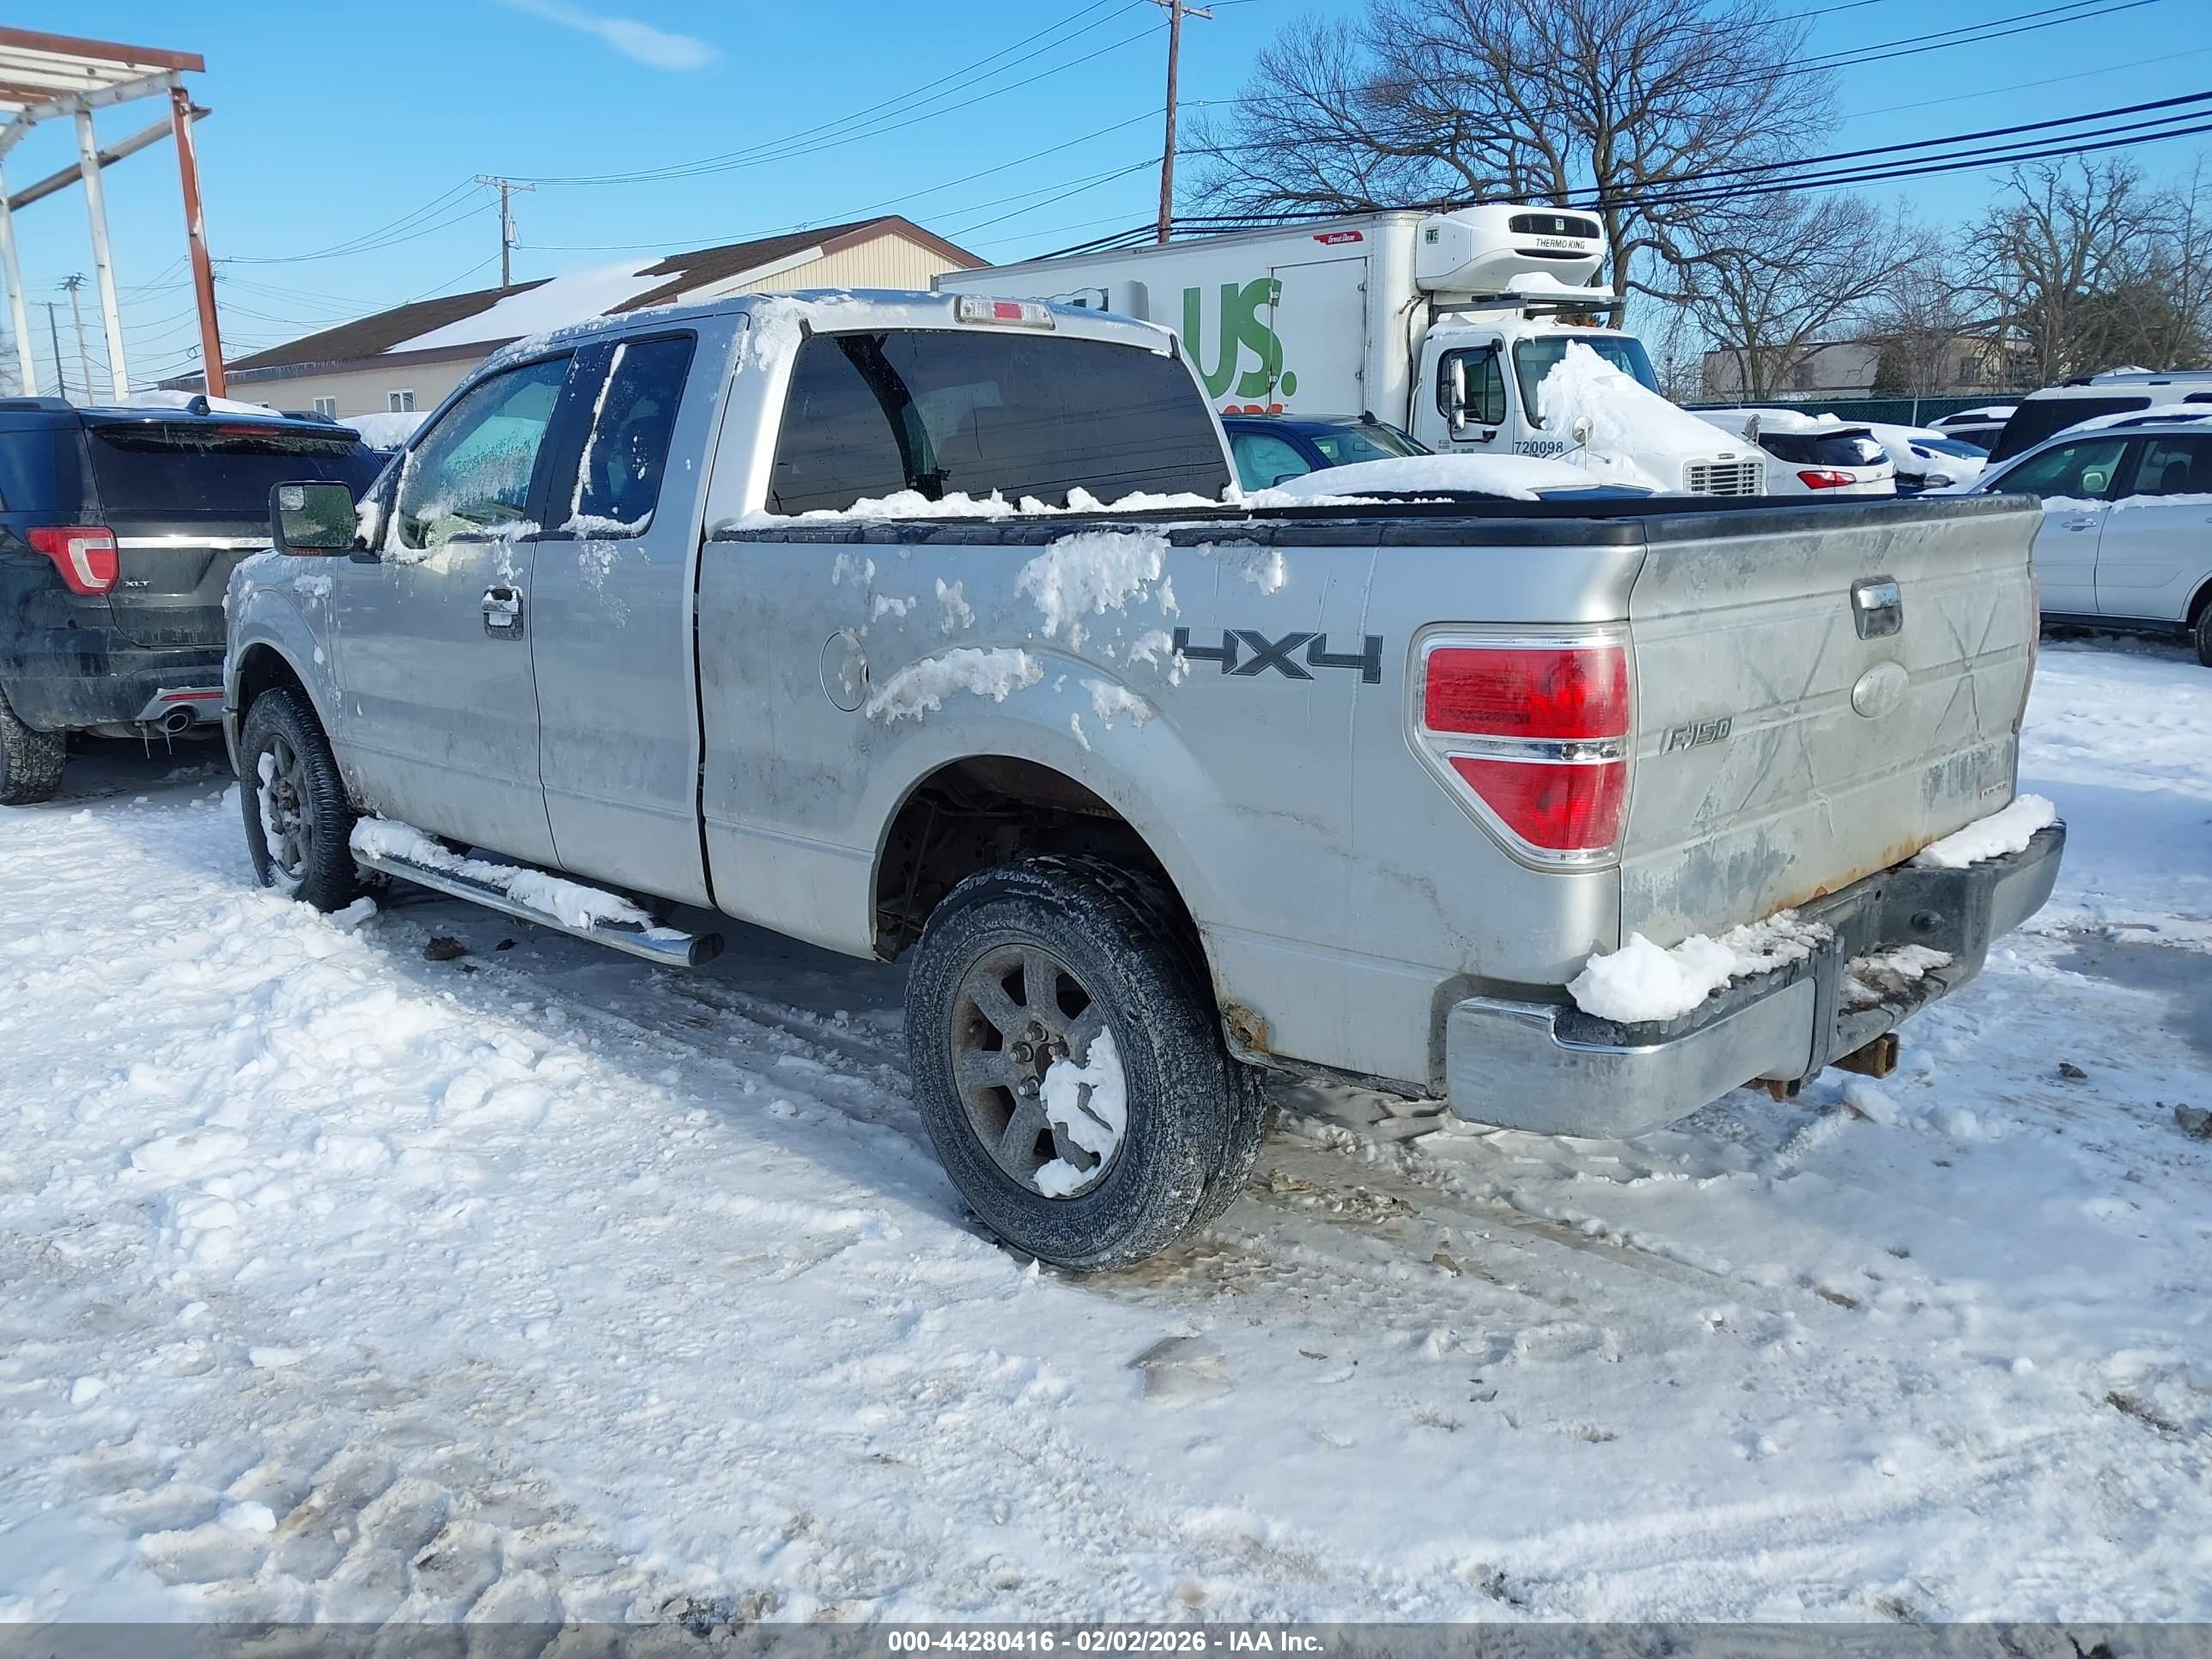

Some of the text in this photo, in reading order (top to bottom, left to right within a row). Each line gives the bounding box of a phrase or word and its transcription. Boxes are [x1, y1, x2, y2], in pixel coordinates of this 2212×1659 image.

[1535, 238, 1586, 249] THERMO KING
[1515, 441, 1564, 454] 720098
